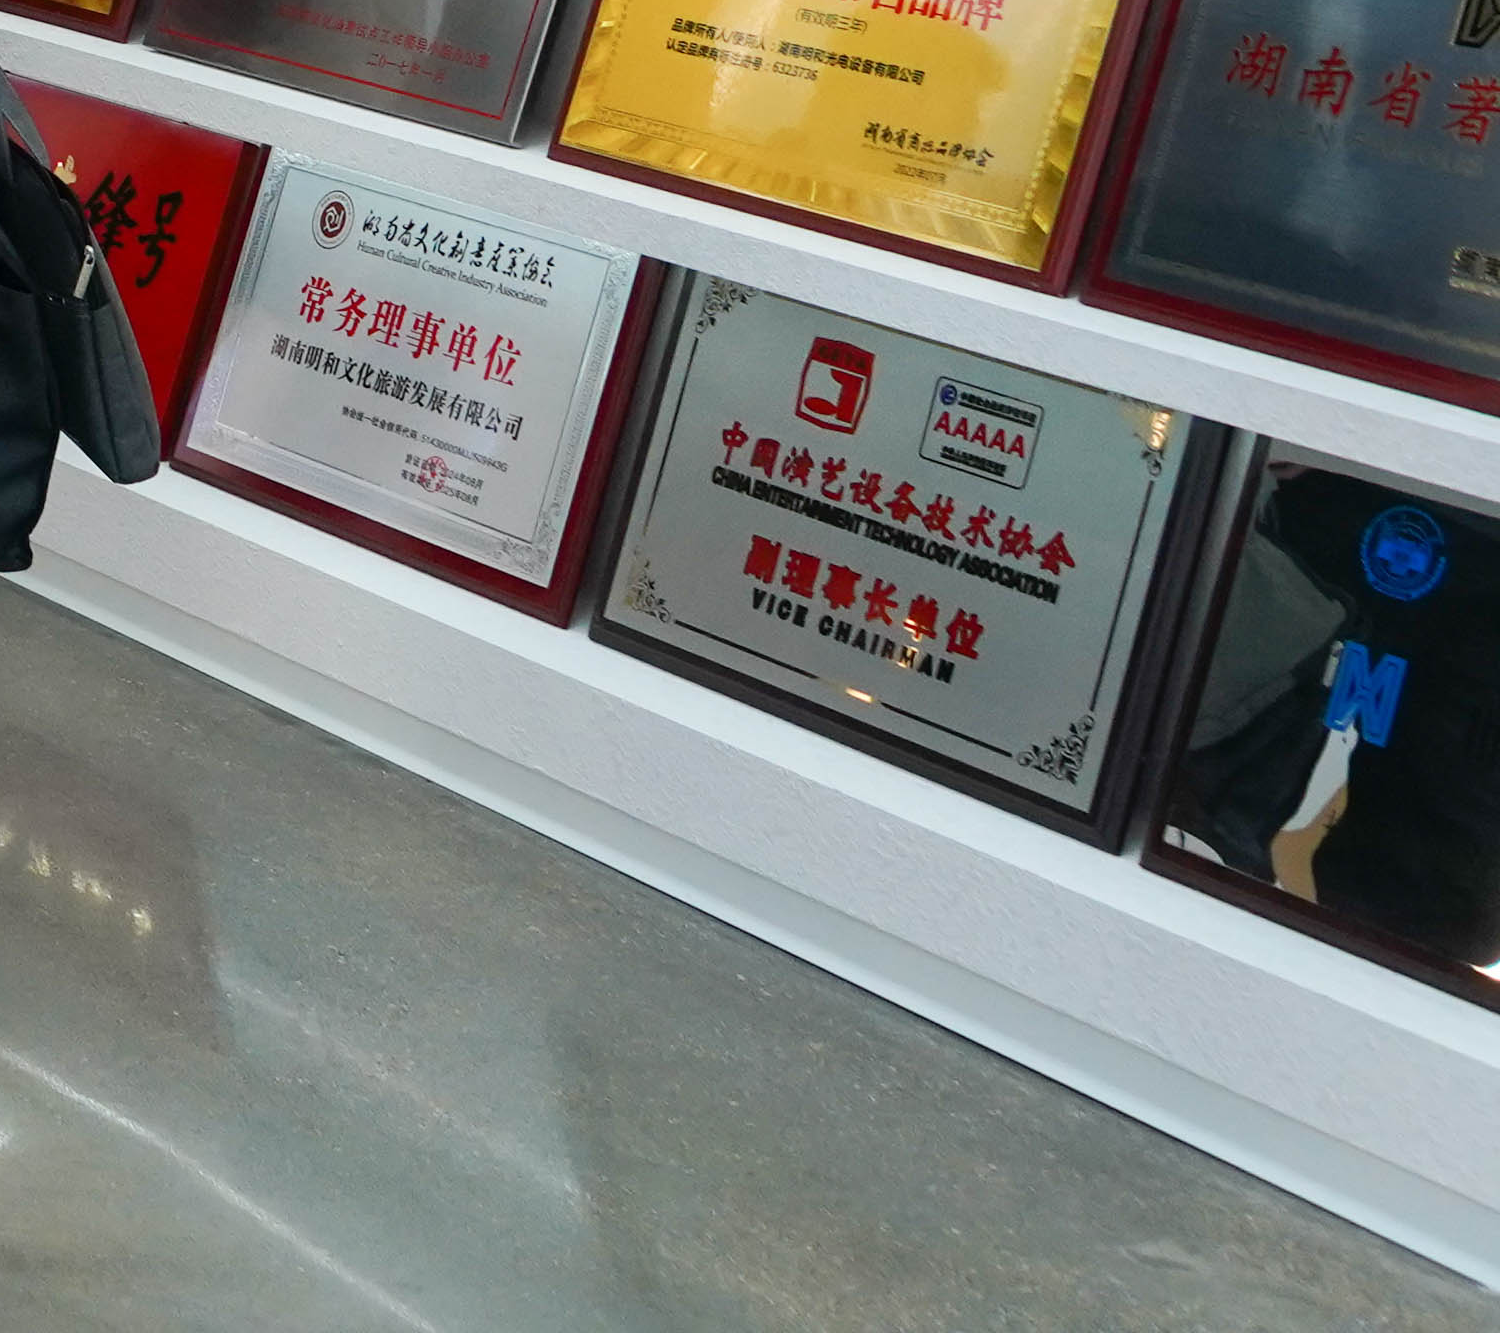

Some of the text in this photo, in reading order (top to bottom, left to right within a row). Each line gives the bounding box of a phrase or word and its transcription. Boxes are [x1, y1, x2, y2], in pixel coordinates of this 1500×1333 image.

[296, 275, 524, 388] 常务理事单位
[269, 332, 524, 441] 湖南明和文化旅游发展有限公司
[933, 410, 1026, 459] AAAAA
[721, 420, 1076, 577] 中国演艺设备技术协会
[743, 533, 984, 661] 副理事长单位
[863, 513, 960, 569] TECHNOLOGY
[957, 550, 1061, 605] ASSOCIATION
[751, 586, 956, 684] VICE CHAIRMAN
